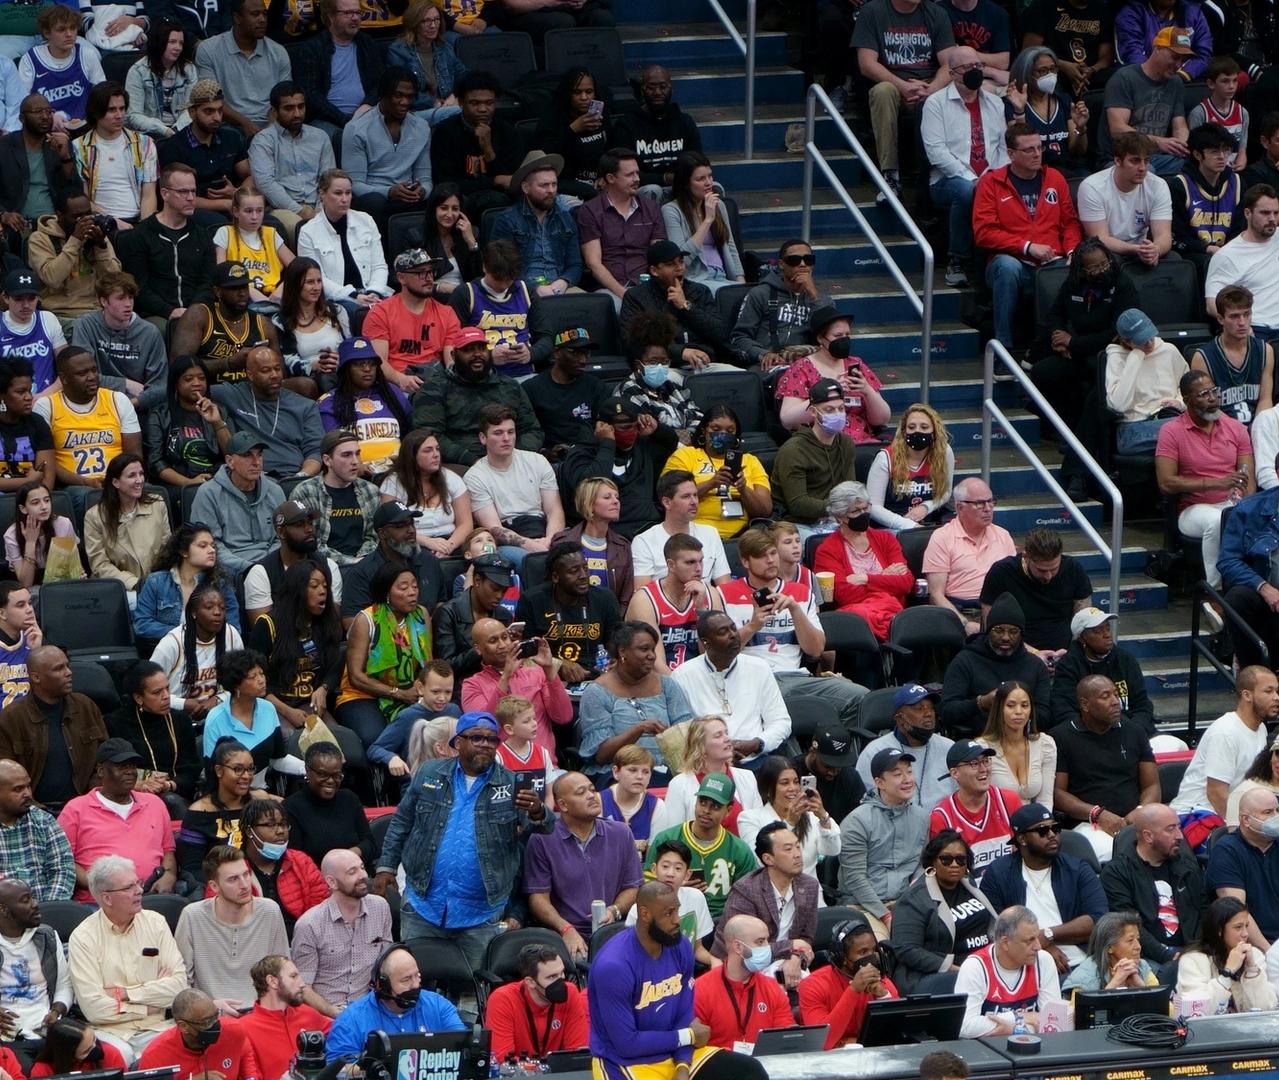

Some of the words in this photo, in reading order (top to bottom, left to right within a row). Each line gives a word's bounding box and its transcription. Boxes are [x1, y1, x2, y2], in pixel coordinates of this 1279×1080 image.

[883, 32, 931, 47] WASHINGTON
[37, 80, 84, 101] LAKERS
[478, 310, 527, 329] LAKERS
[1, 339, 49, 359] LAKERS
[208, 340, 236, 359] LAK
[63, 429, 113, 449] LAKERS
[73, 448, 106, 476] 23
[765, 635, 778, 653] 2
[975, 842, 1012, 863] zards
[420, 1048, 461, 1071] Replay
